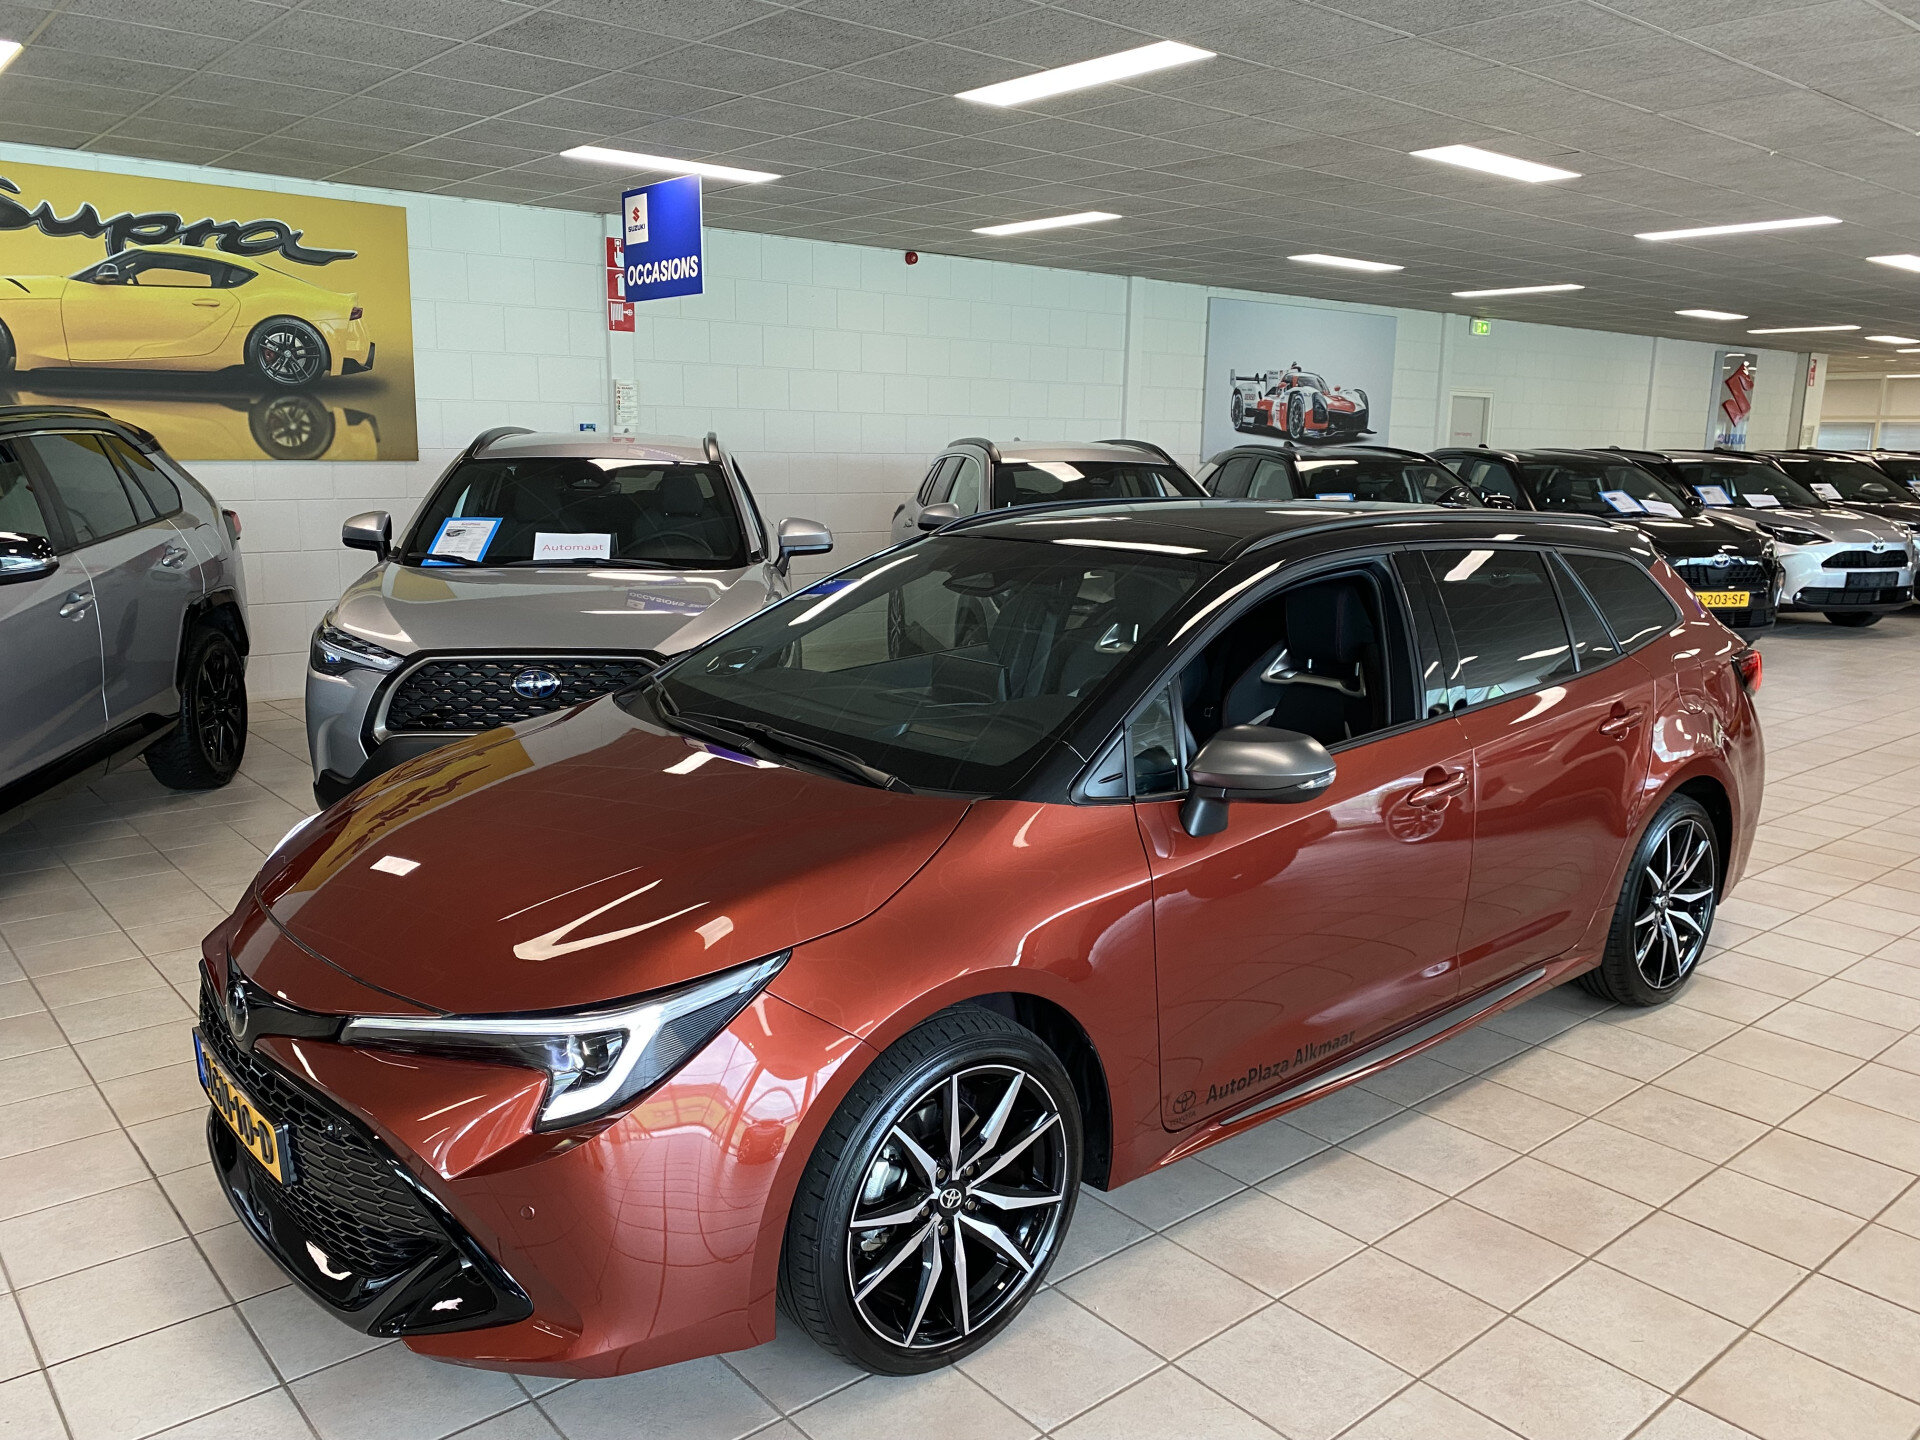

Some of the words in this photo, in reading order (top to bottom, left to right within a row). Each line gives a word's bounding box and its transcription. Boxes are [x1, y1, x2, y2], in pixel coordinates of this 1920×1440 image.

[628, 224, 645, 232] SUZUKI
[627, 255, 698, 286] OCCASIONS
[542, 544, 604, 552] Automaat
[1206, 1059, 1289, 1103] AutoPlaza
[1294, 1031, 1355, 1067] Alkmaar
